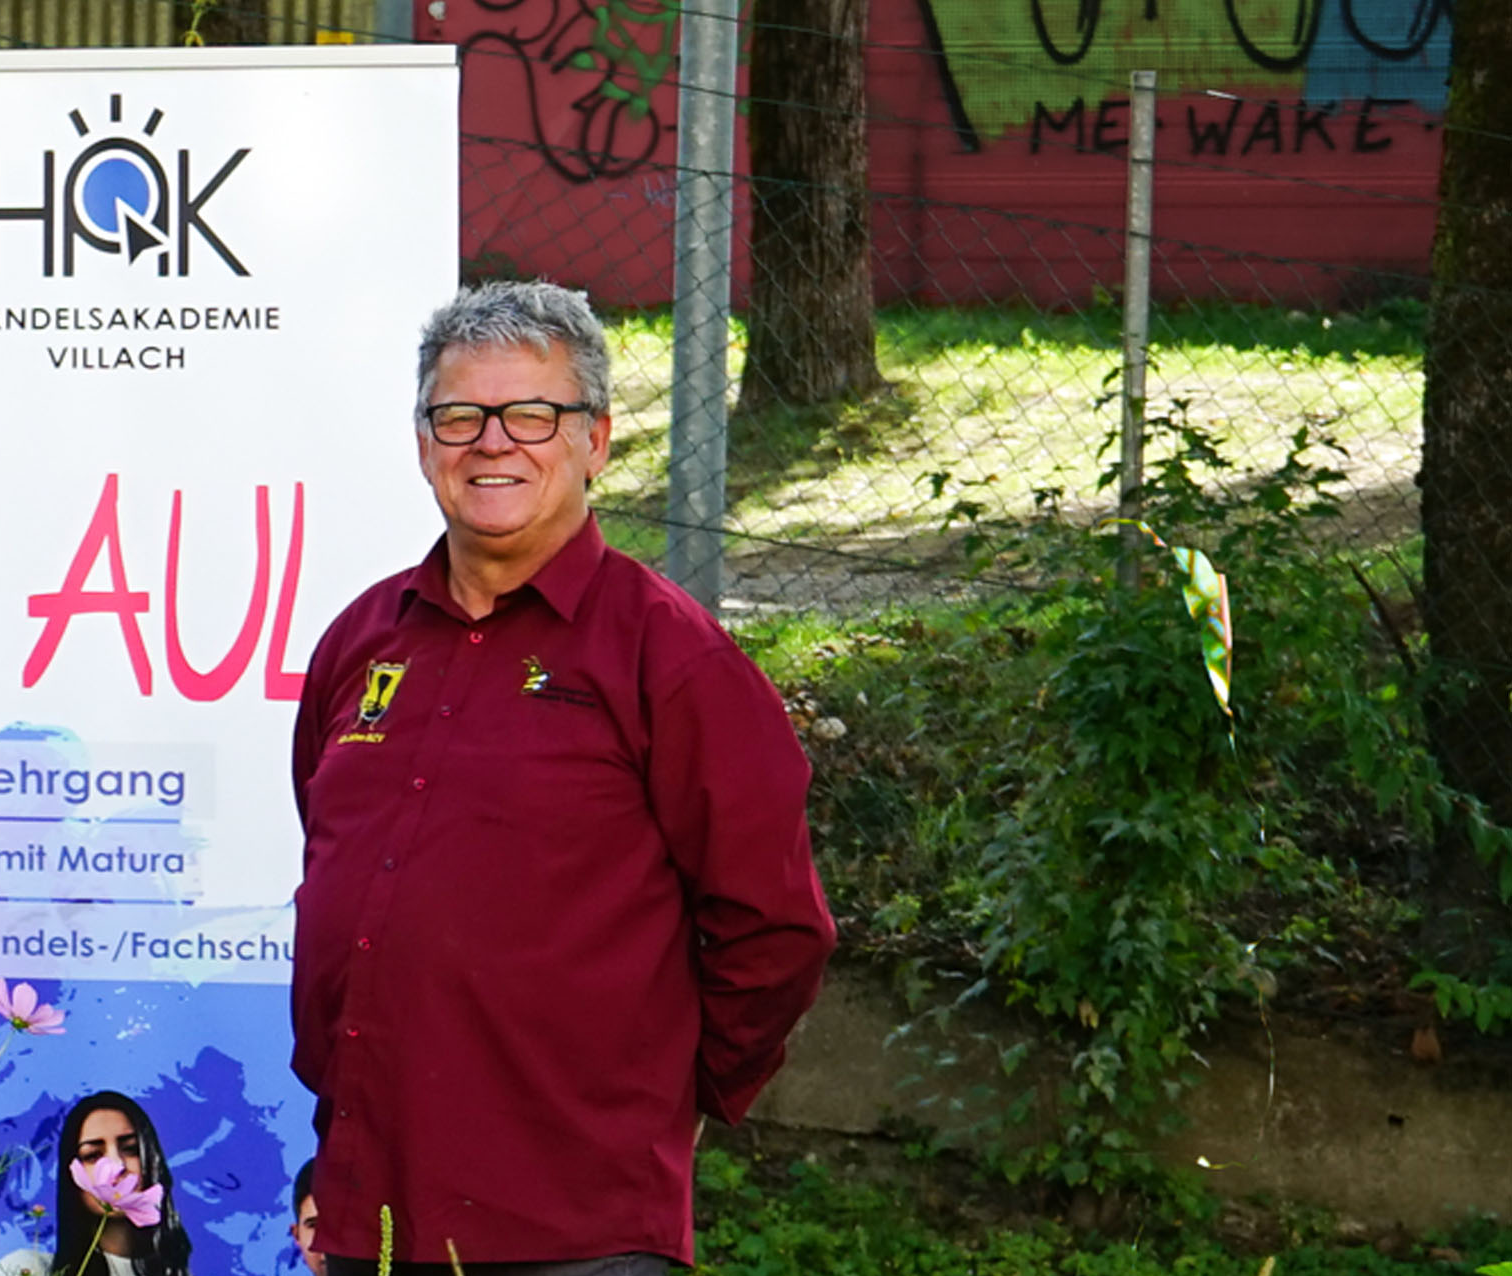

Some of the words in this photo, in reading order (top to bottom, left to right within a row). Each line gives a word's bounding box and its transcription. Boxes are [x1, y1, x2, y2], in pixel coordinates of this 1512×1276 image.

[47, 346, 187, 370] VILLACH
[22, 473, 308, 702] AUL
[58, 845, 185, 874] Matura
